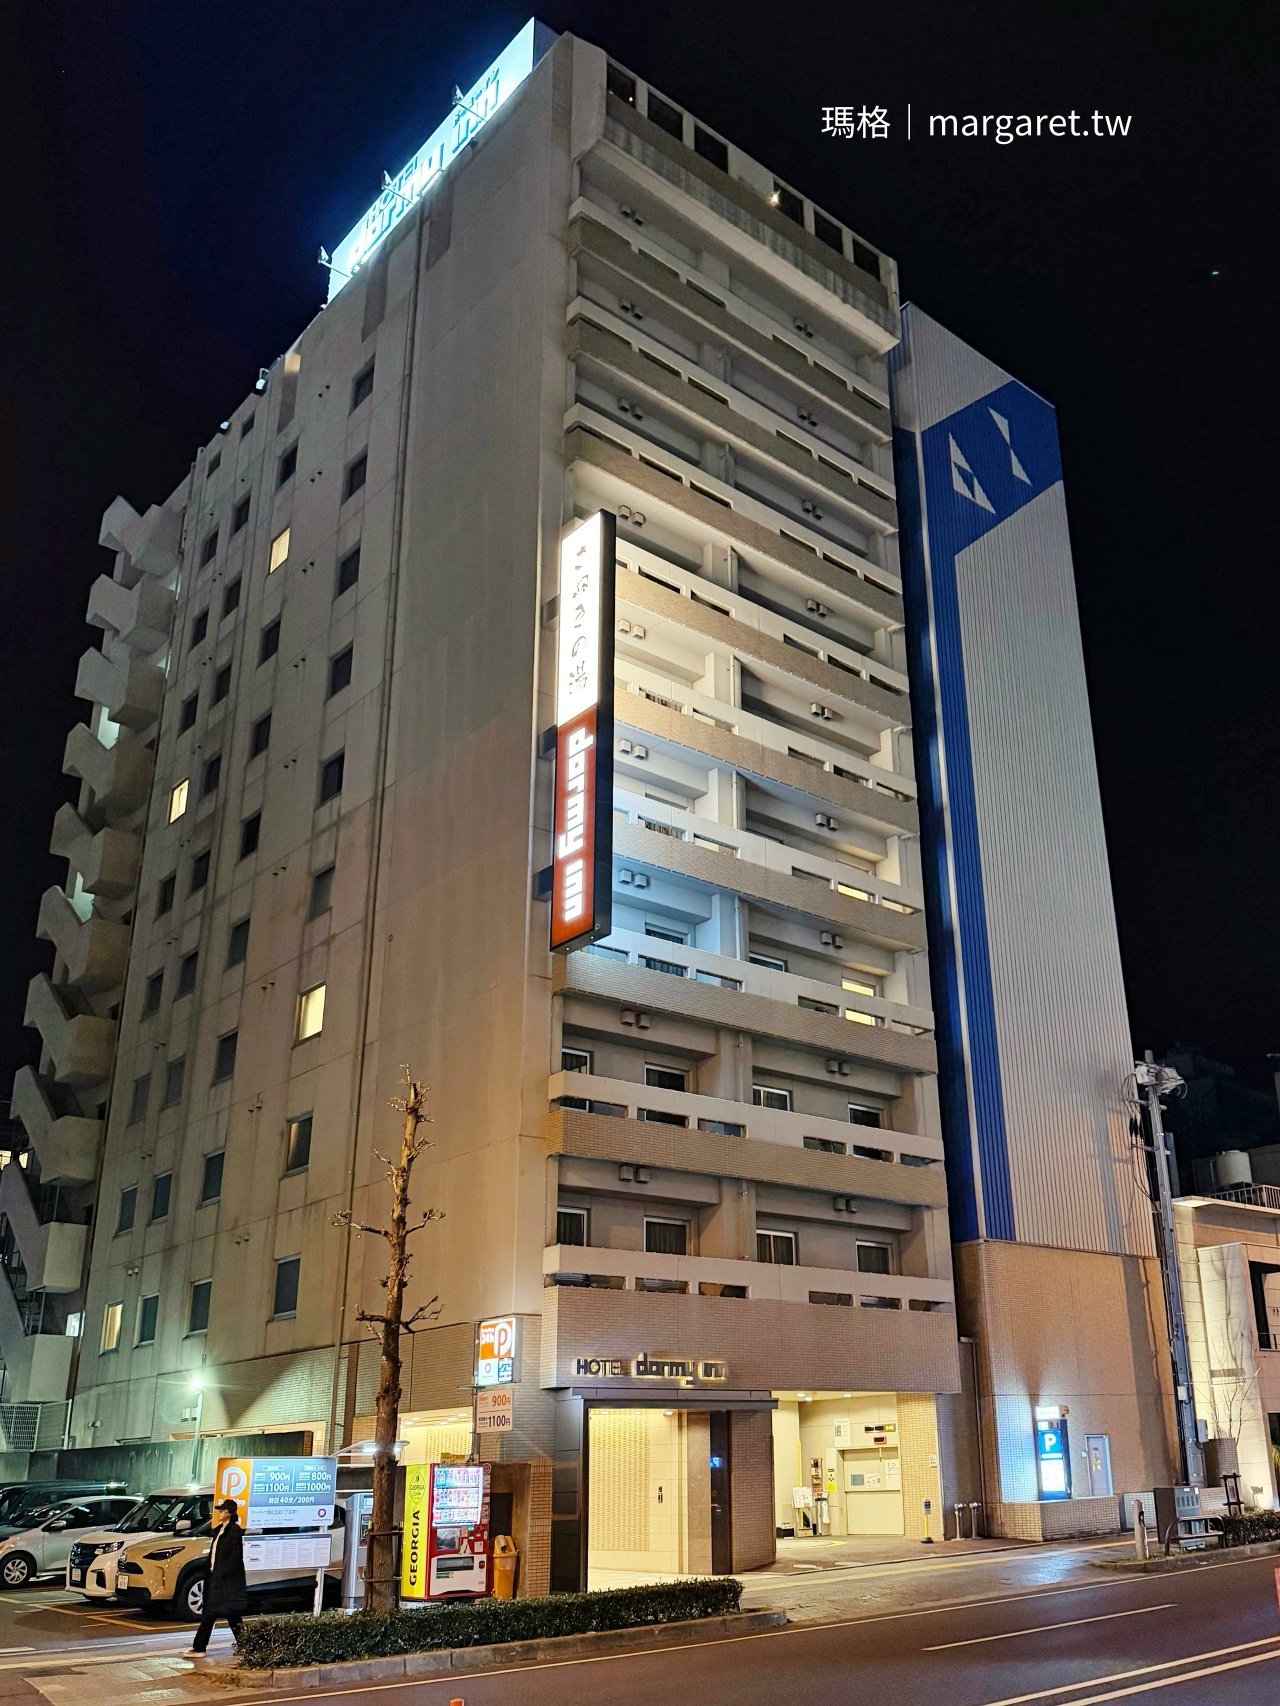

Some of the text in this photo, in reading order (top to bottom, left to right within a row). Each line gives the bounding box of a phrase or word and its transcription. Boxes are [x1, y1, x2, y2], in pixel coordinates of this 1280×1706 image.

[558, 727, 594, 922] dormy inn
[575, 1358, 623, 1376] HOTEL
[633, 1352, 695, 1386] dormy
[1044, 1433, 1057, 1452] P
[409, 1509, 420, 1586] GEORGIA
